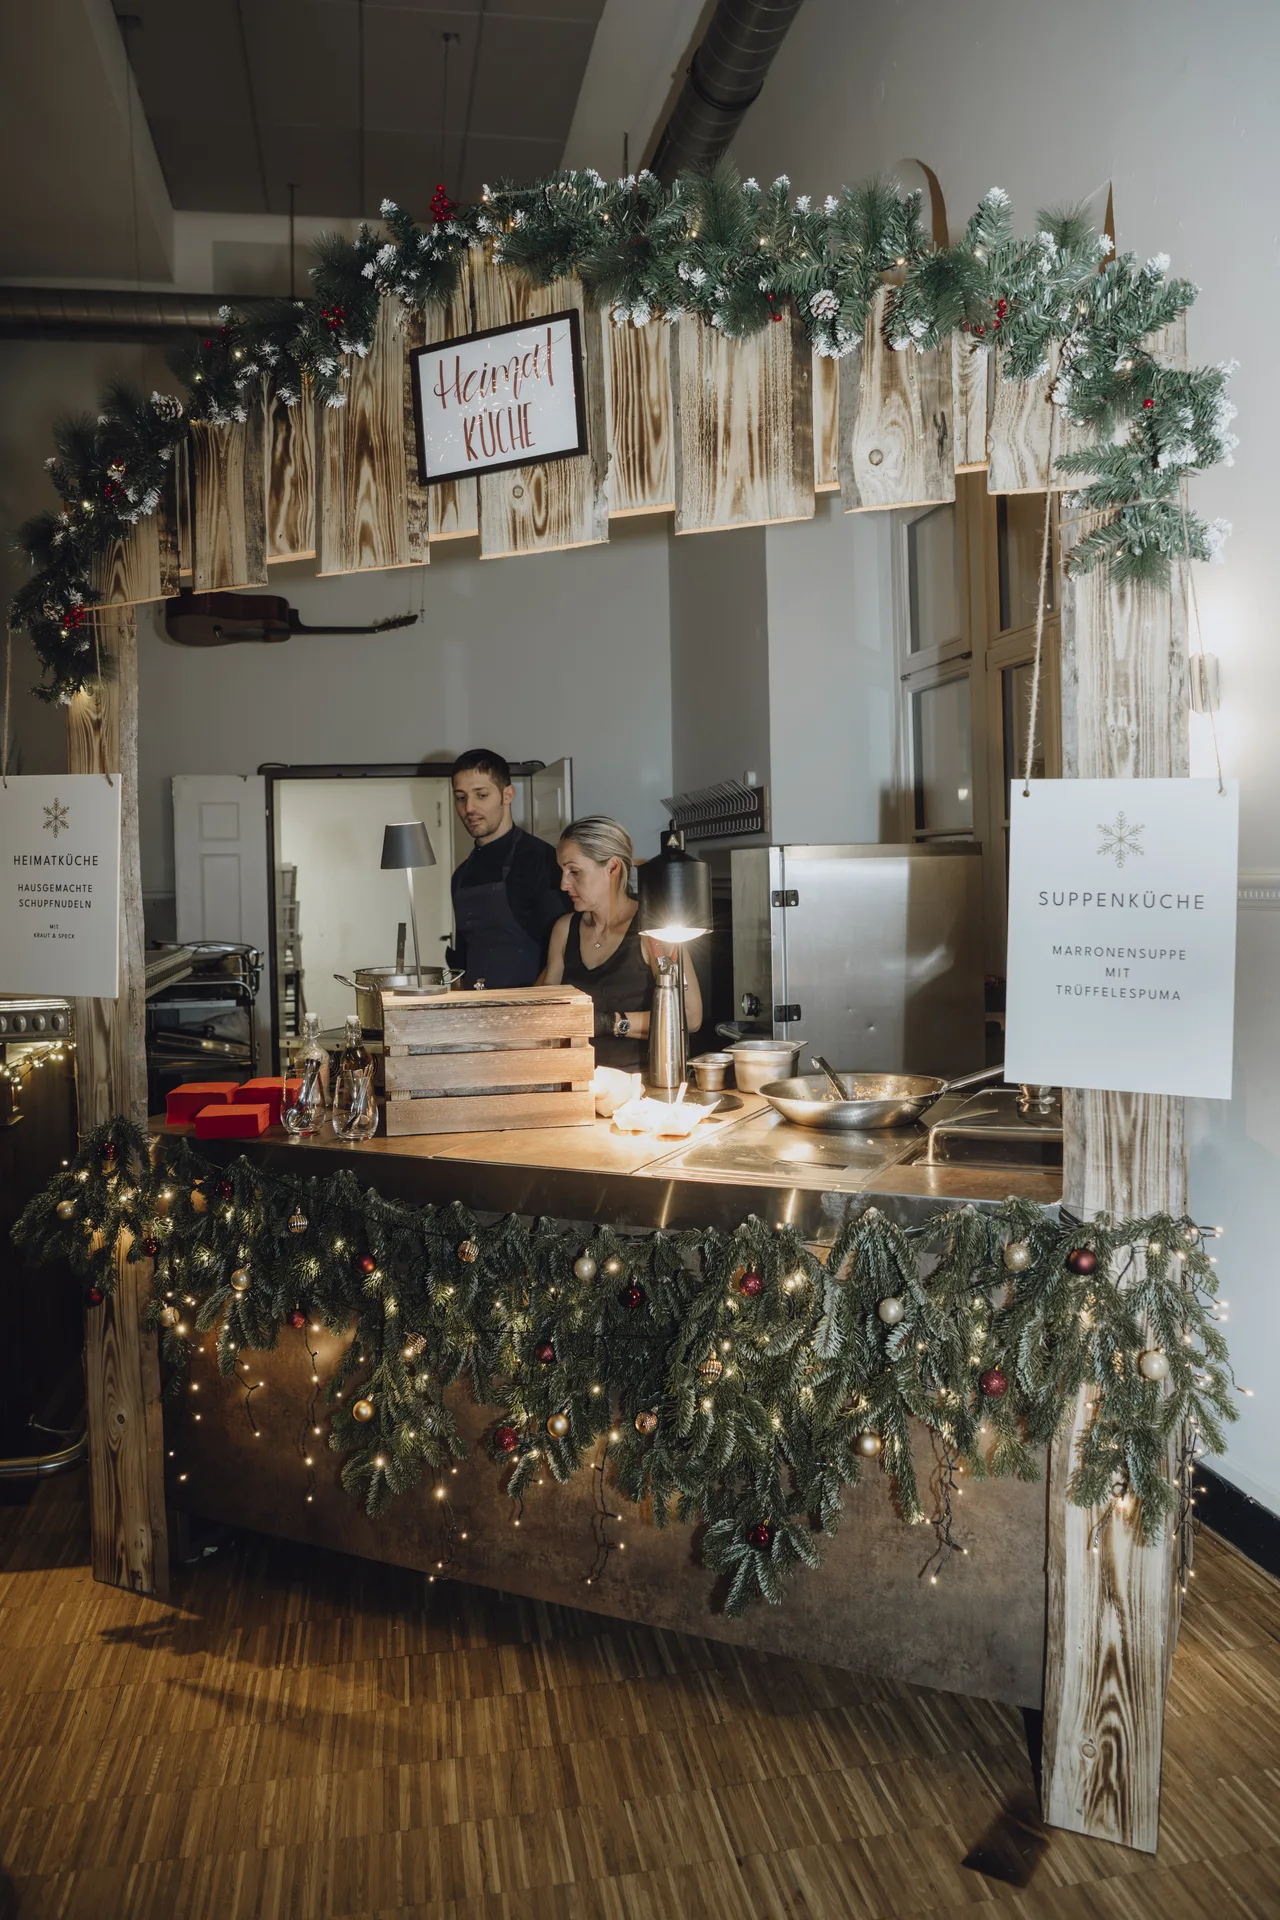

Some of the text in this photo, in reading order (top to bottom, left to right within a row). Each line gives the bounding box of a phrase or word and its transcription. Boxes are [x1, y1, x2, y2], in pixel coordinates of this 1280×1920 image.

[433, 327, 567, 409] Heimat
[463, 402, 536, 461] KÜCHE
[13, 853, 98, 866] HEIMATKÜCHE
[17, 884, 93, 892] HAUSGEMACHTE
[18, 899, 92, 908] SCHUPFNUDELN
[1038, 890, 1205, 910] SUPPENKÜCHE
[1052, 945, 1187, 961] MARRONENSUPPE
[1105, 967, 1130, 978] MIT
[1056, 984, 1181, 1001] TRÜFFELESPUMA
